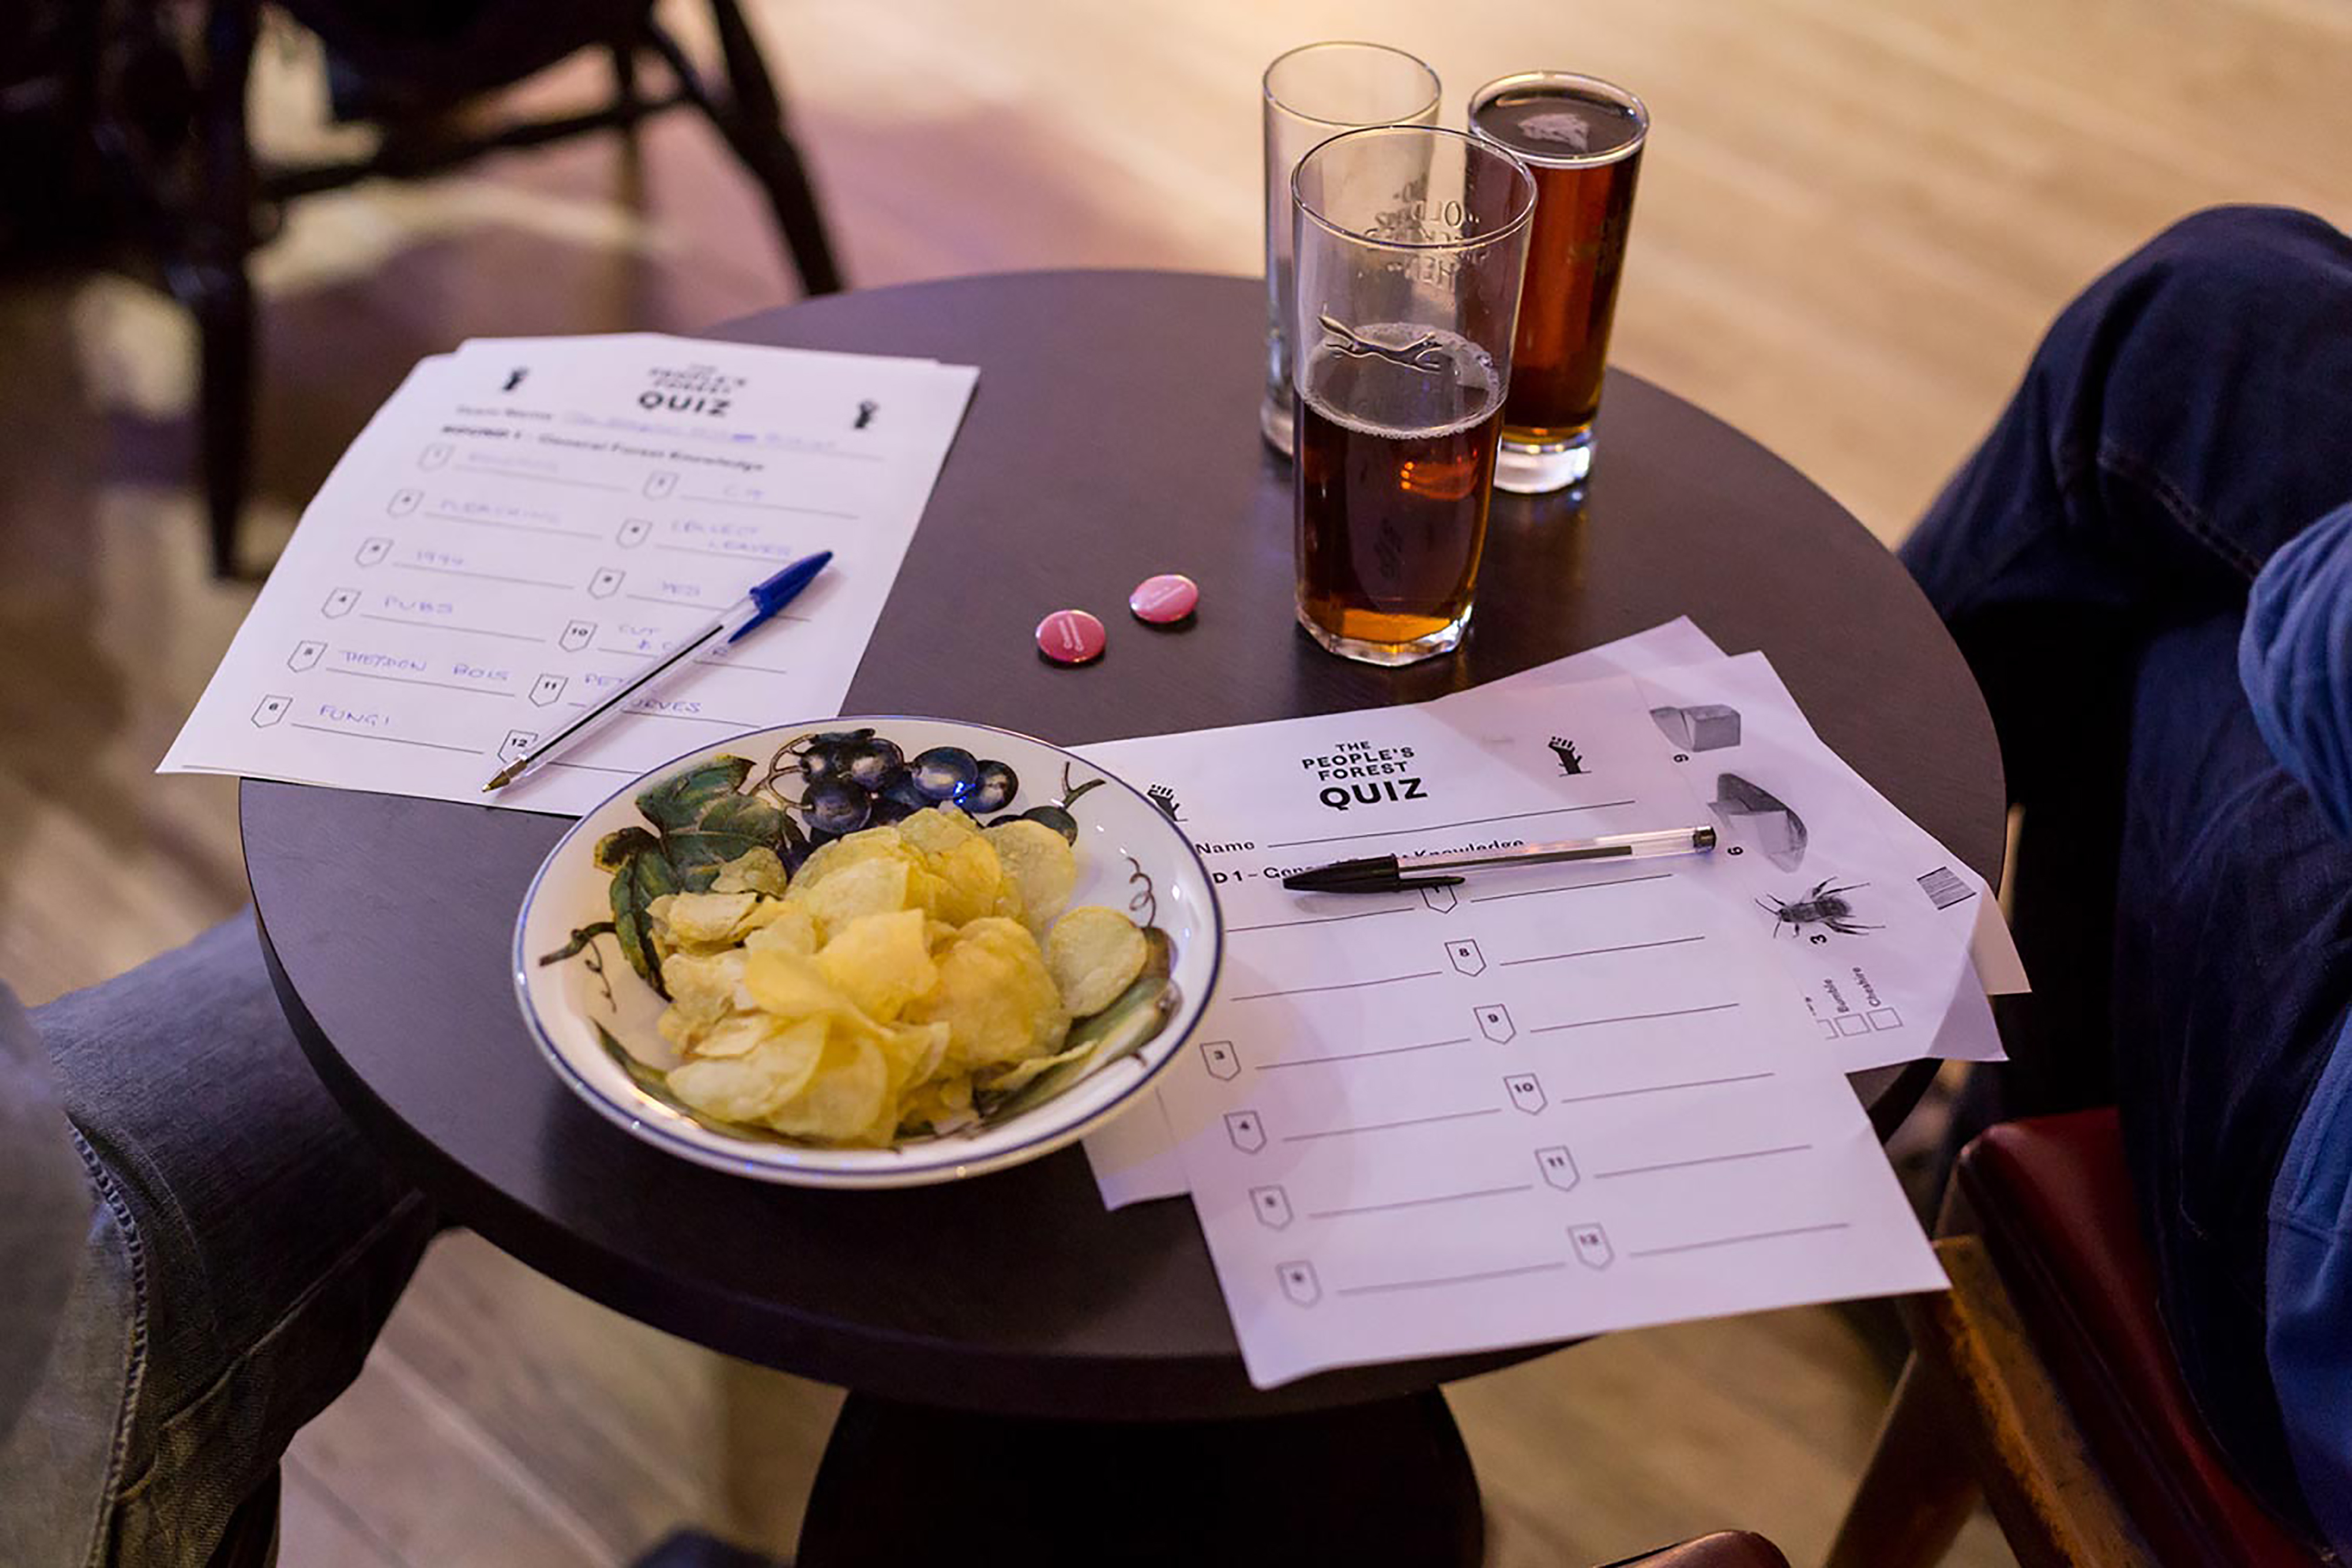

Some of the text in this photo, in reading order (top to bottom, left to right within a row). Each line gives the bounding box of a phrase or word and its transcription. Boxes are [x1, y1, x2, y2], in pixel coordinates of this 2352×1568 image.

[638, 391, 730, 416] QUIZ
[572, 628, 588, 637] 10
[544, 681, 557, 690] 11
[319, 705, 389, 727] FUNGI
[512, 738, 527, 747] 12
[1335, 741, 1371, 753] THE
[1302, 747, 1415, 769] PEOPLE'S
[1318, 761, 1408, 781] FOREST
[1319, 778, 1428, 811] QUIZ
[1195, 841, 1255, 854] Name
[1459, 947, 1469, 958] 8
[1488, 1014, 1499, 1024] 9
[1214, 1051, 1225, 1061] 3
[1514, 1082, 1534, 1094] 10
[1548, 1157, 1565, 1168] 11
